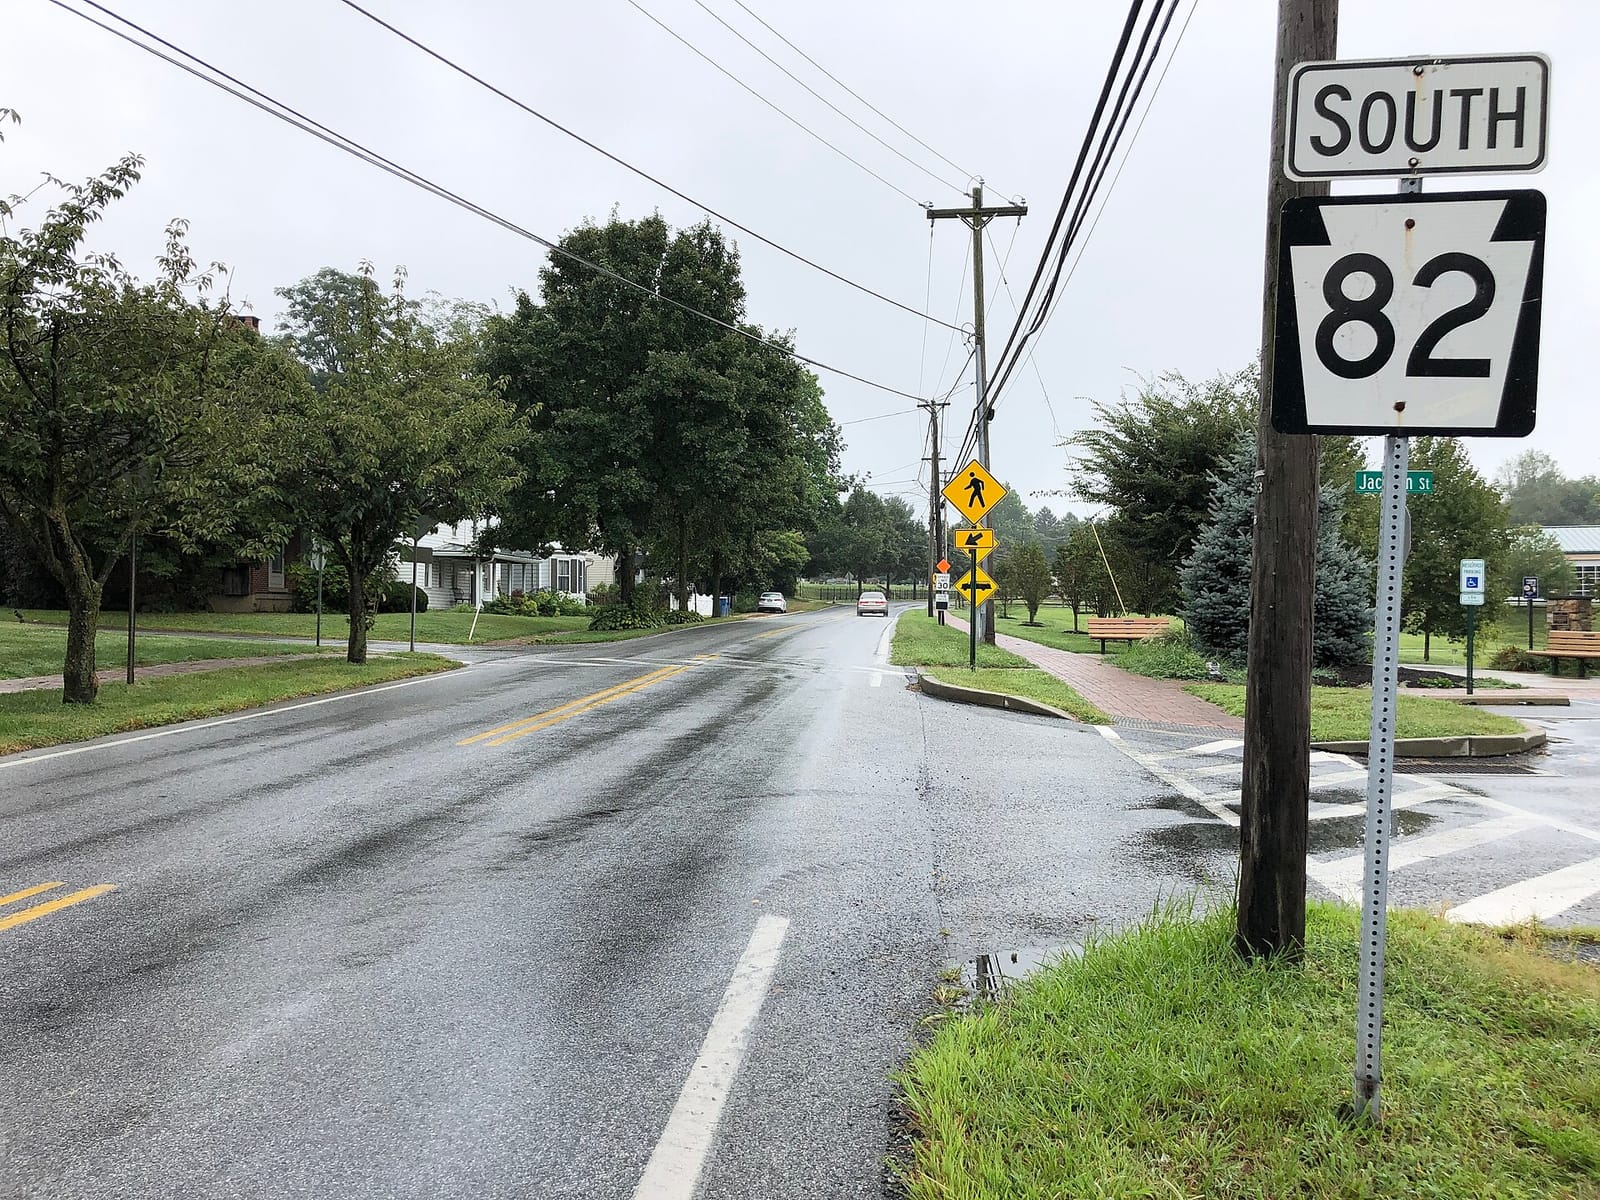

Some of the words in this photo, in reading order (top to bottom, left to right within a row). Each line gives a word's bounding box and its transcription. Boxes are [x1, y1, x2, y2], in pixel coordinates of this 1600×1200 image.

[1309, 84, 1526, 157] SOUTH
[1315, 252, 1496, 379] 82
[1359, 473, 1413, 490] Jacn
[1419, 477, 1430, 490] St
